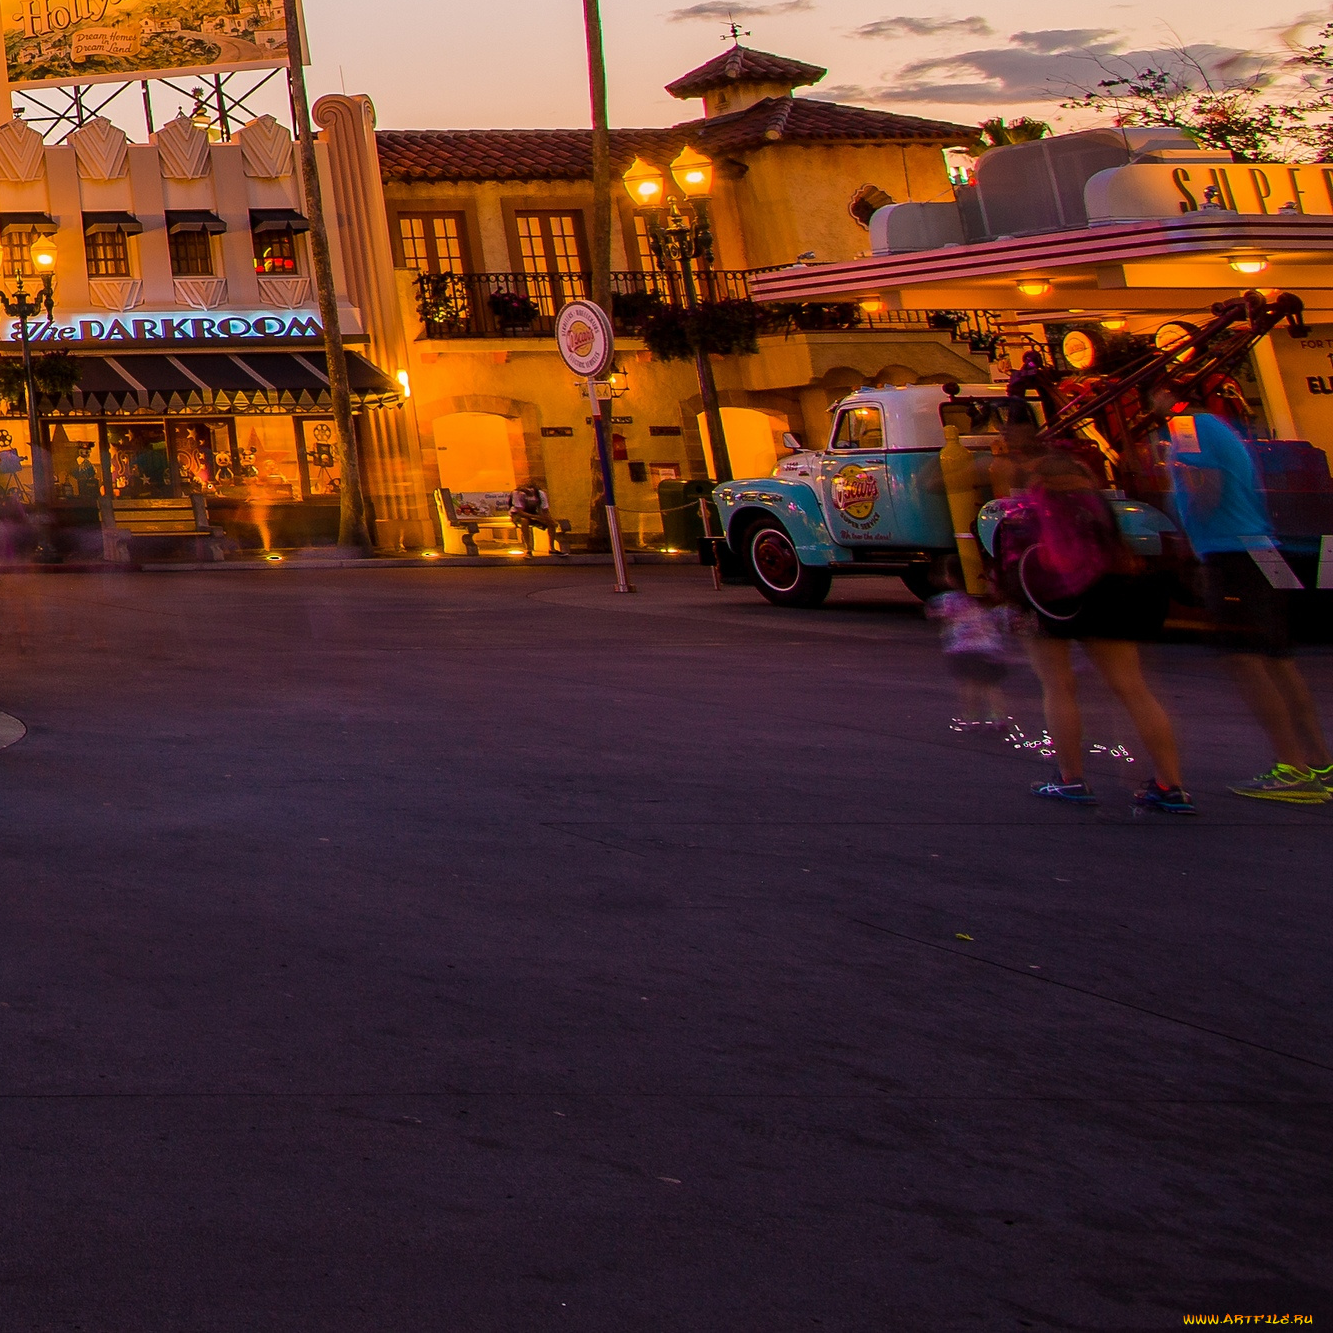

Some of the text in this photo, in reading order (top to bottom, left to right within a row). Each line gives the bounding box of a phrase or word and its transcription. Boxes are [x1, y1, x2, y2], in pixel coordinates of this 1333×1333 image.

[76, 31, 138, 42] Dream Homes
[75, 42, 133, 54] Dream Land
[9, 316, 324, 341] The DARKROOM
[1300, 339, 1324, 349] FOR
